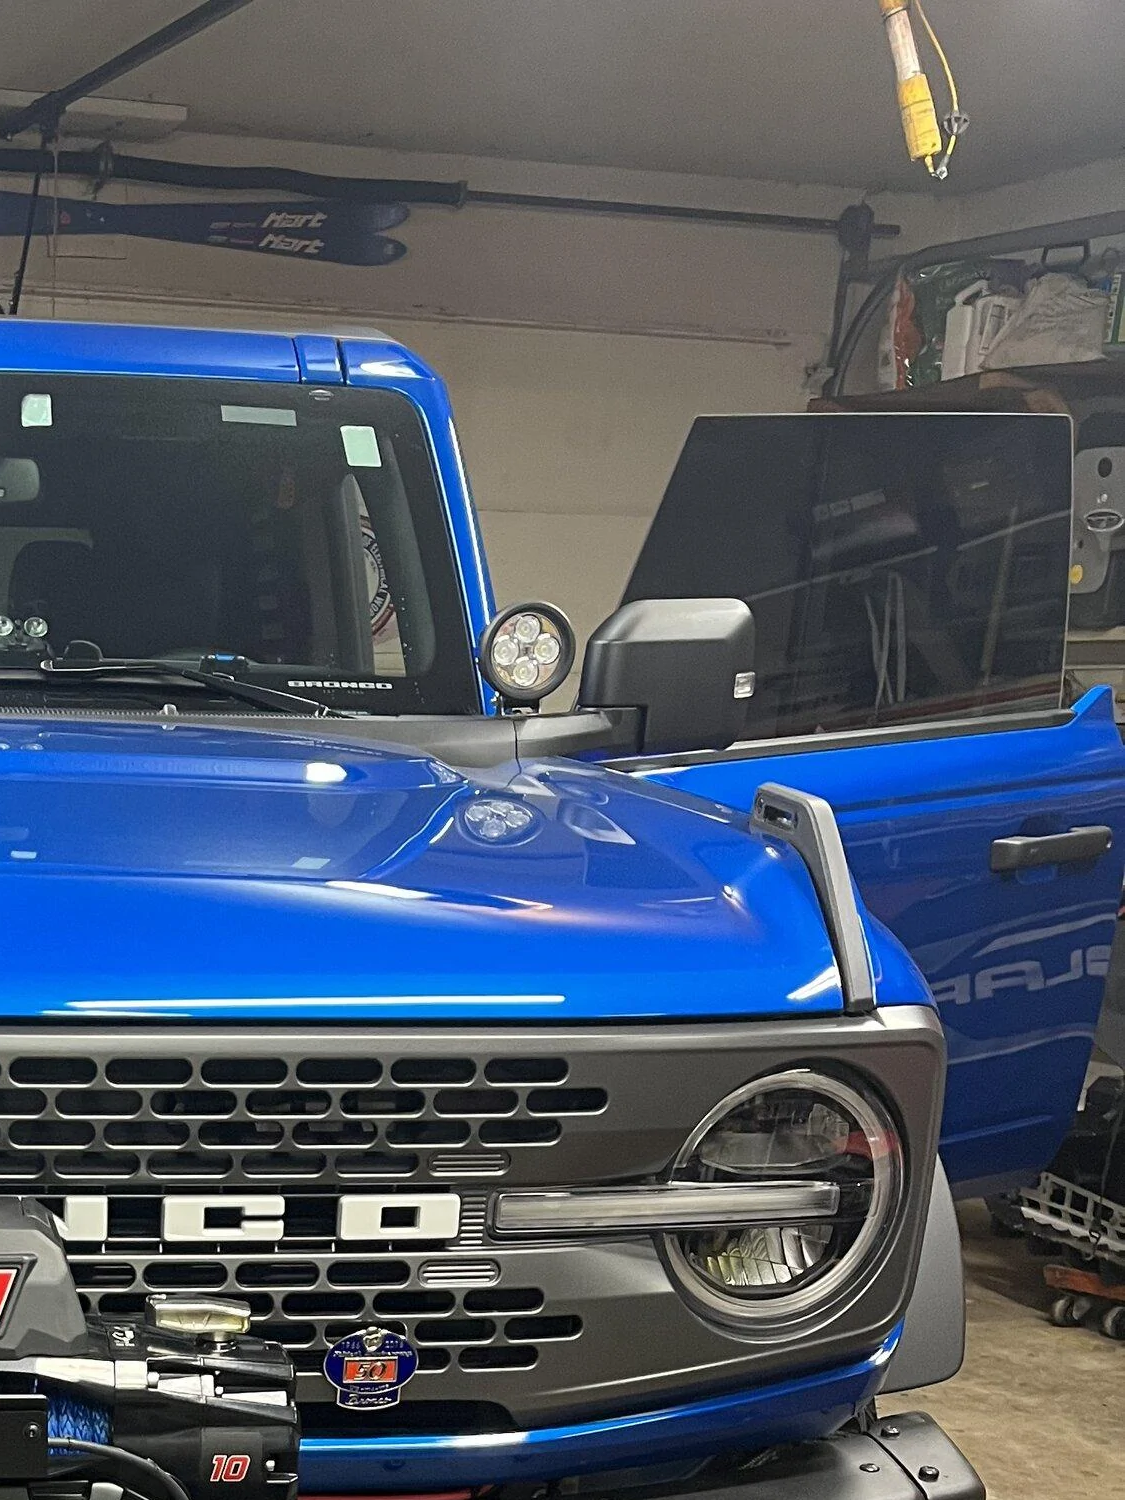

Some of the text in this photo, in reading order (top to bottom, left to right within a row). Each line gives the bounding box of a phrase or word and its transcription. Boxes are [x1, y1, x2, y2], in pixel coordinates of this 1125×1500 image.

[287, 680, 393, 690] BRONCO
[354, 1360, 387, 1381] 50
[209, 1454, 251, 1482] 10
